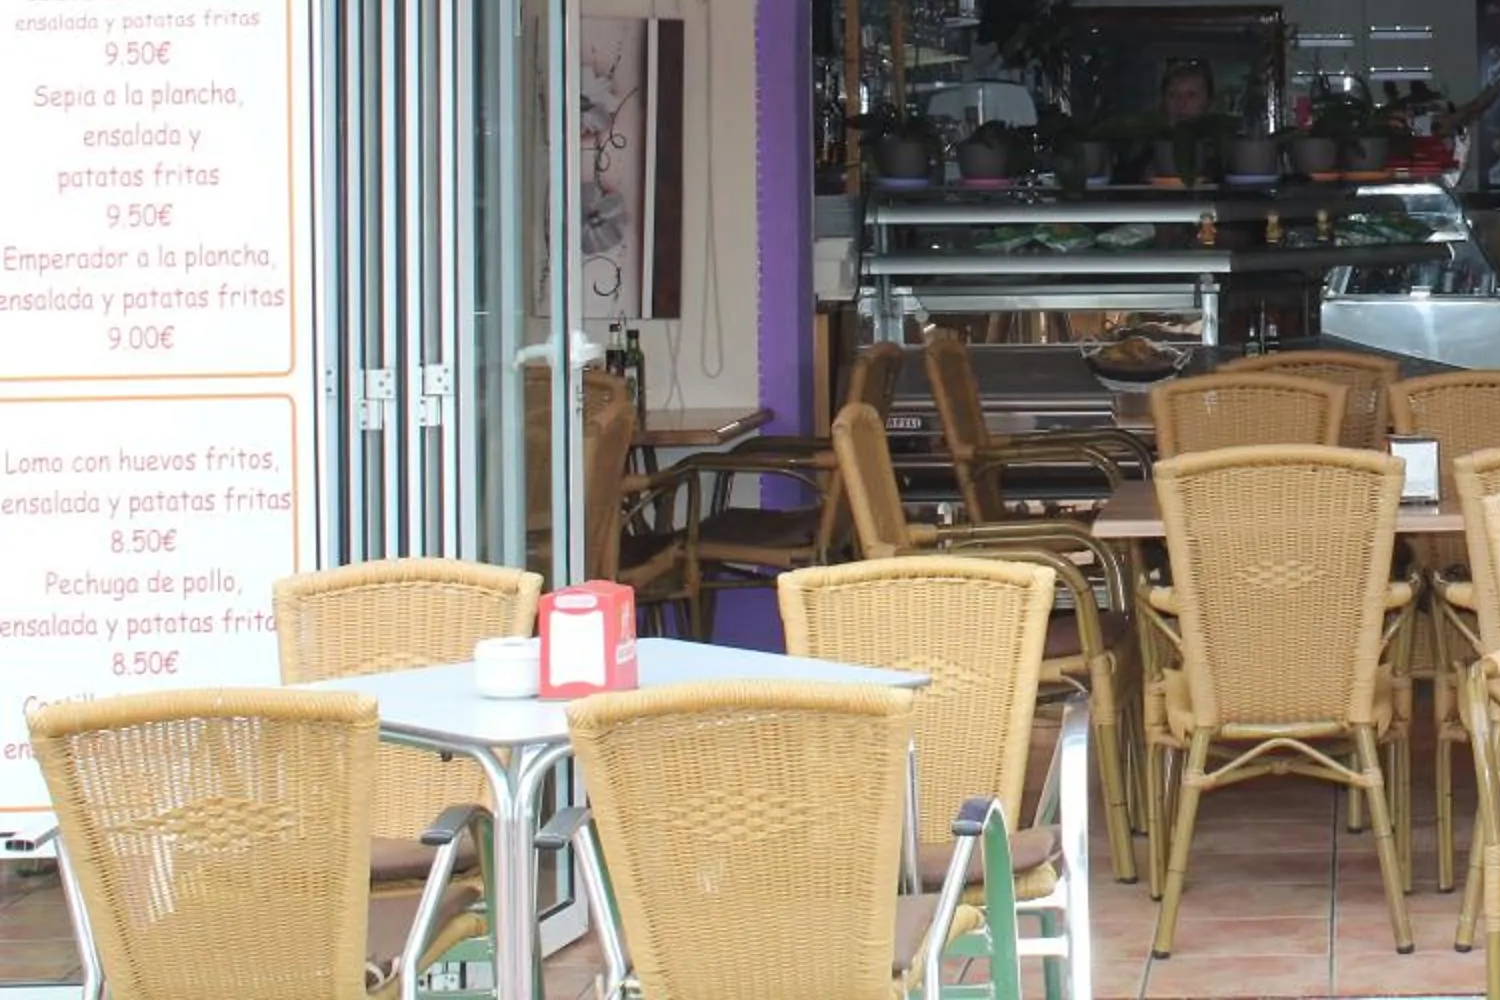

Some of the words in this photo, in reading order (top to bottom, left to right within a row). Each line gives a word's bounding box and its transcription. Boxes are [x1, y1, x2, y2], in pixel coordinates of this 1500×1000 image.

[14, 12, 99, 32] ensalada
[104, 16, 116, 34] y
[121, 13, 196, 33] patatas
[203, 8, 261, 28] fritas
[104, 41, 172, 66] 9.50€
[33, 84, 97, 113] Sepia
[102, 88, 117, 107] a
[124, 82, 144, 107] la
[151, 79, 244, 113] plancha,
[82, 121, 182, 148] ensalada
[189, 129, 202, 152] y
[57, 165, 145, 195] patatas
[153, 161, 220, 188] fritas
[106, 203, 174, 229] 9.50€
[3, 245, 129, 278] Emperador
[136, 250, 150, 269] a
[158, 244, 178, 269] la
[184, 243, 277, 275] plancha,
[0, 286, 95, 312] ensalada
[101, 293, 115, 316] y
[122, 287, 210, 317] patatas
[217, 282, 286, 309] fritas
[108, 325, 176, 351] 9.00€
[71, 454, 111, 474] con
[118, 446, 197, 472] huevos
[204, 445, 280, 473] fritos,
[1, 489, 101, 516] ensalada
[107, 496, 121, 520] y
[128, 490, 217, 520] patatas
[223, 486, 292, 512] fritas
[110, 529, 178, 554] 8.50€
[45, 570, 140, 601] Pechuga
[147, 570, 175, 594] de
[182, 567, 243, 599] pollo,
[0, 611, 98, 638] ensalada
[105, 618, 119, 643] y
[126, 612, 214, 642] patatas
[112, 650, 180, 677] 8.50€
